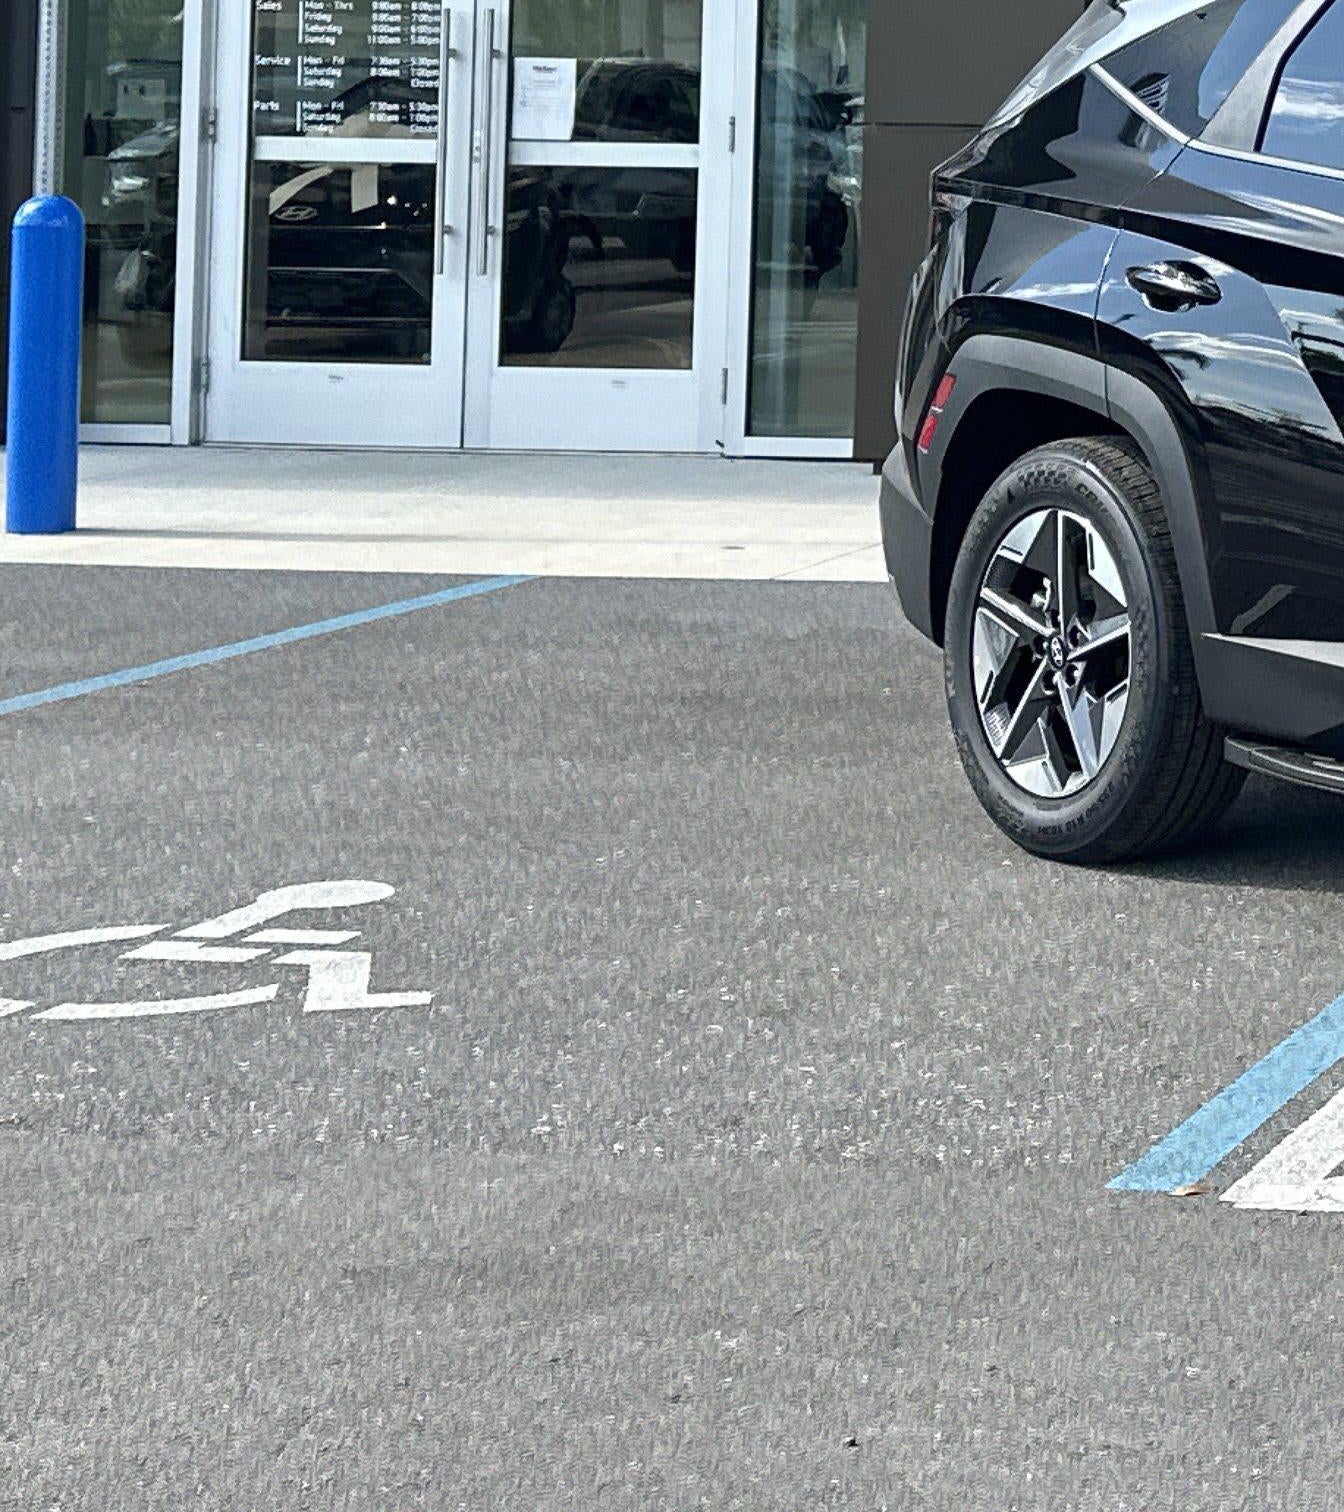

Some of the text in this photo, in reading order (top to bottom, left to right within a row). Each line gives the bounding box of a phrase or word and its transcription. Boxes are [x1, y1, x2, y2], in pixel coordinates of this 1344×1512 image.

[304, 11, 332, 23] Friday
[255, 55, 291, 65] Service
[253, 100, 280, 111] Parts
